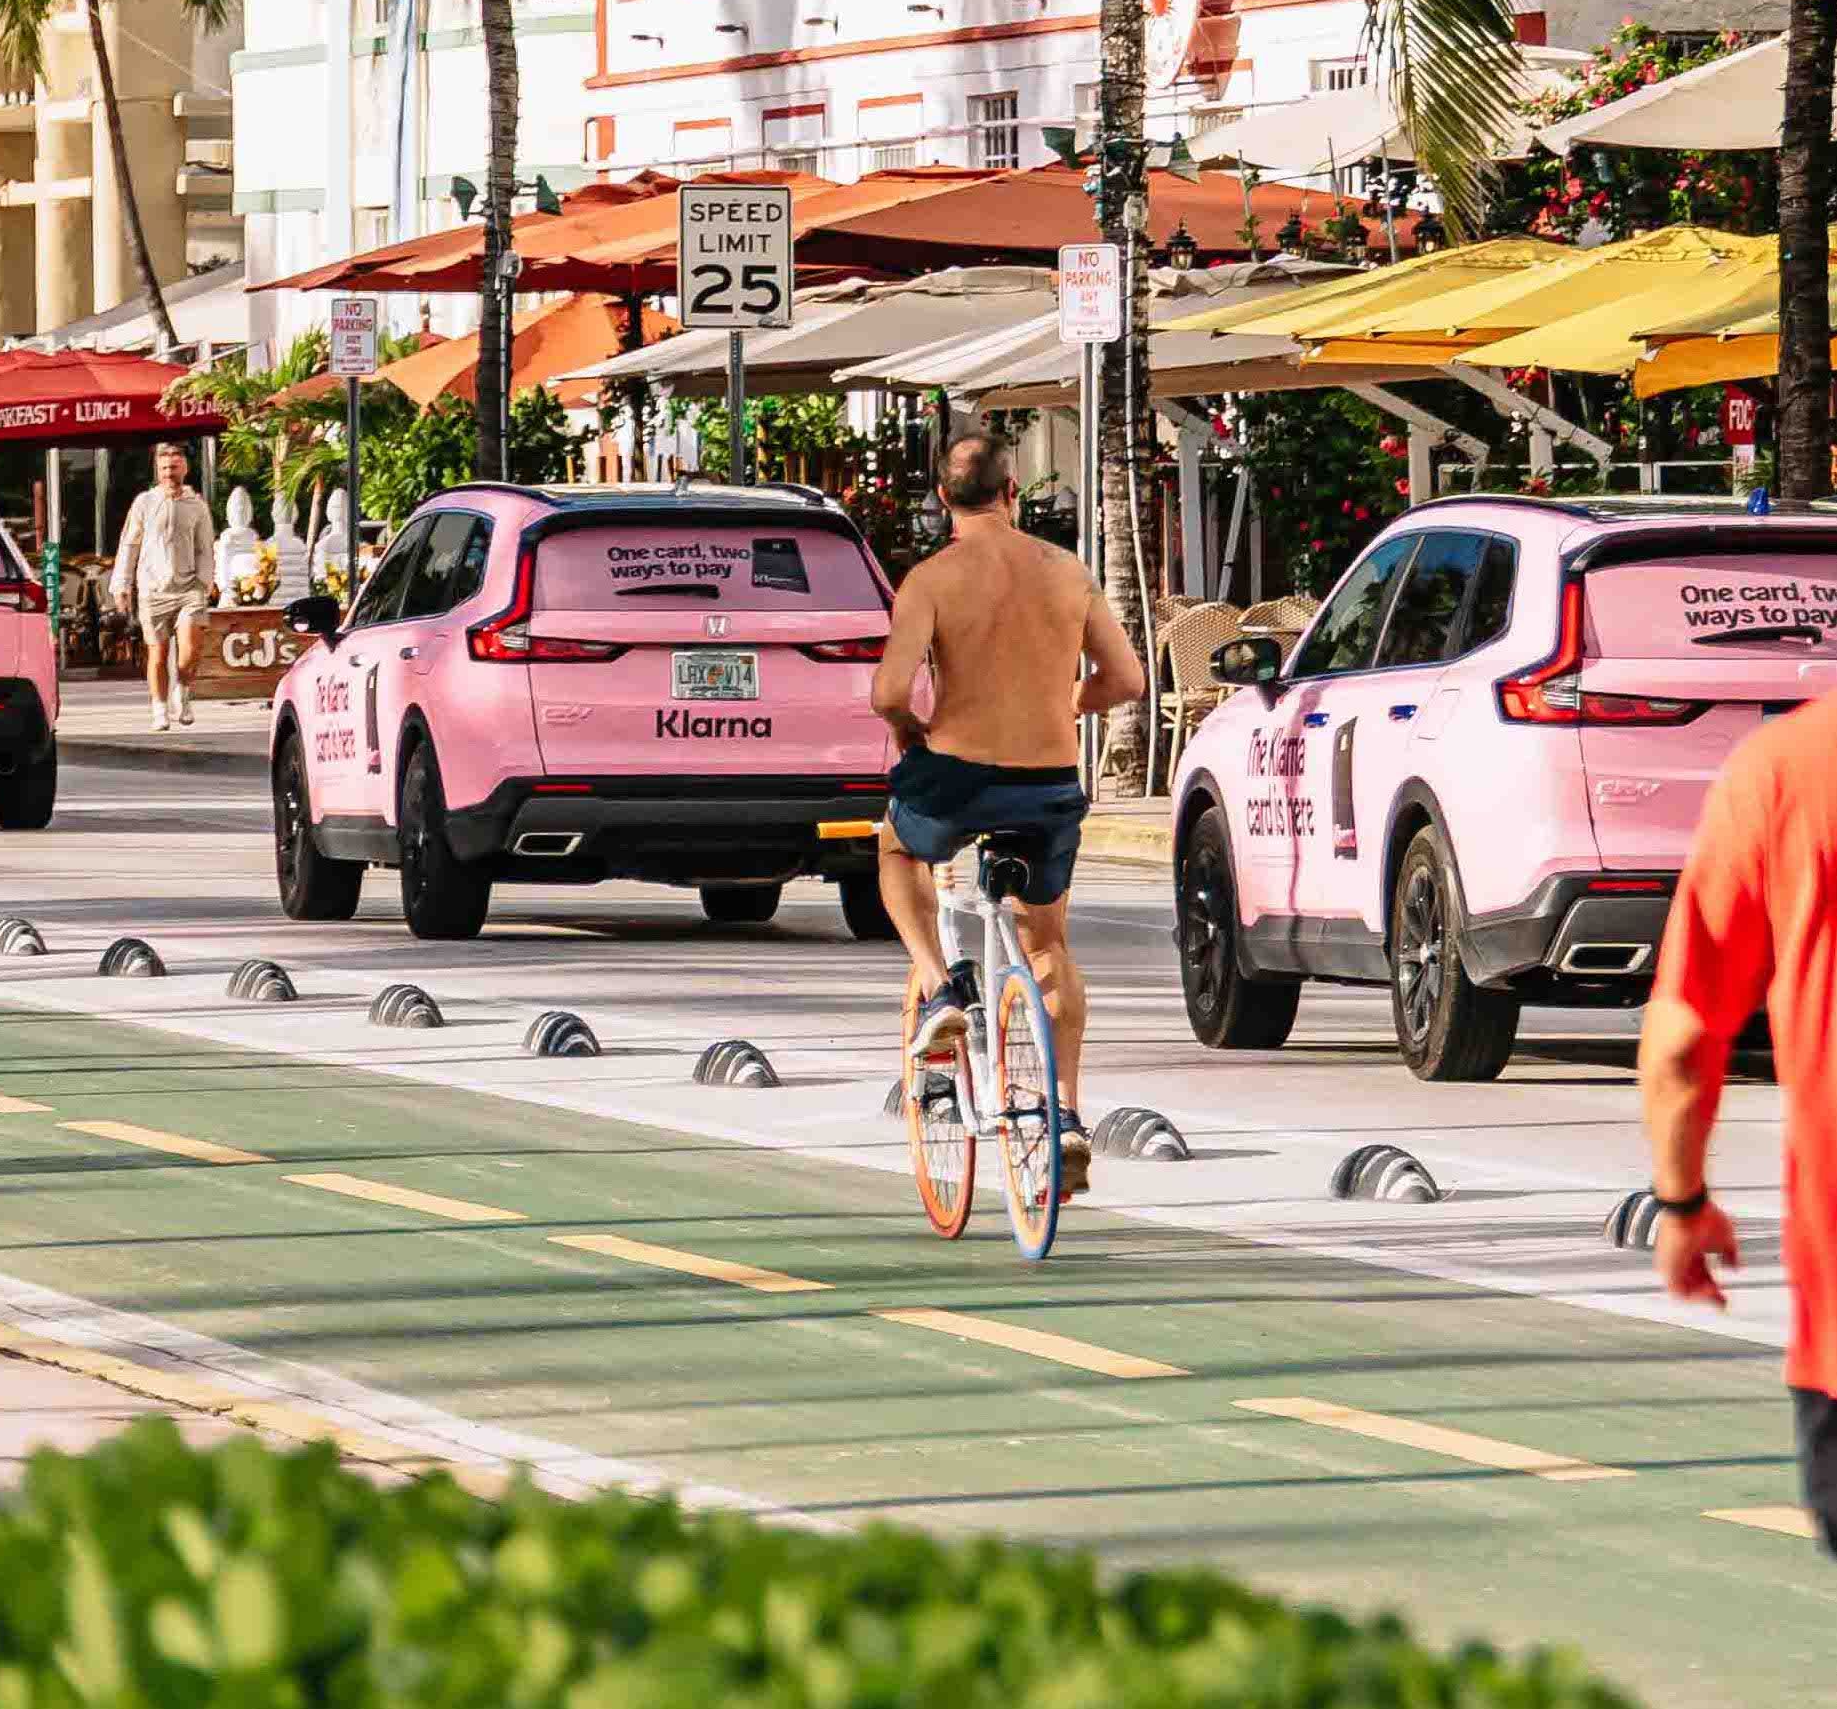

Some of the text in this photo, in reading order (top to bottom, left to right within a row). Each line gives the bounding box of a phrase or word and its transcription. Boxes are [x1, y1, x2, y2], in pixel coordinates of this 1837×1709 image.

[690, 202, 783, 223] SPEED
[699, 233, 772, 253] LIMIT
[1078, 251, 1099, 267] NO
[691, 263, 781, 315] 25
[1065, 271, 1115, 287] PARKING
[75, 400, 131, 423] LUNCH
[607, 543, 751, 561] One card, two
[610, 562, 664, 580] ways
[667, 561, 691, 576] to
[695, 562, 732, 579] pay
[1680, 585, 1734, 604] One
[1739, 582, 1807, 603] card,
[1684, 607, 1756, 630] ways
[1758, 605, 1788, 623] to
[654, 709, 773, 739] Klarna
[1246, 727, 1306, 777] The Klarna
[1246, 783, 1315, 837] card is here
